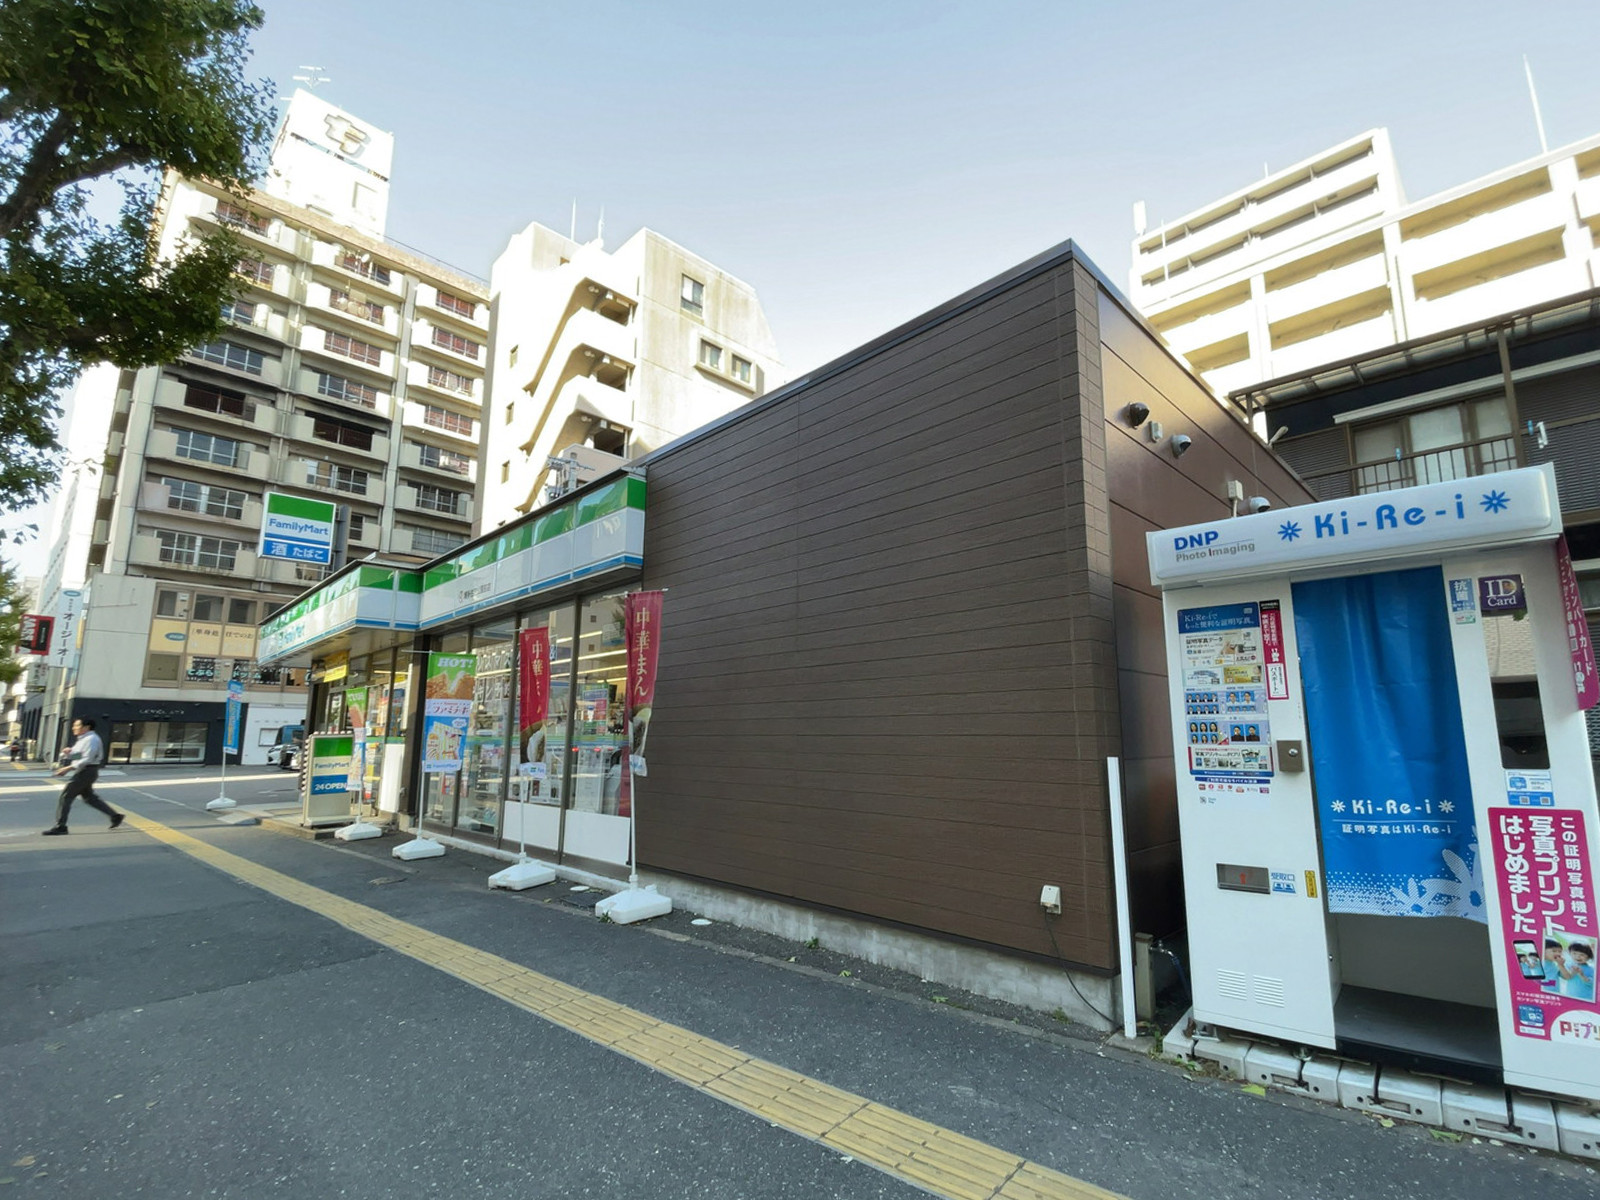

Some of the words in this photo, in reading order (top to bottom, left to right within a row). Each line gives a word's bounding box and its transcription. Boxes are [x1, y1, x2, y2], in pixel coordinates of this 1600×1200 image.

[1315, 493, 1465, 538] Ki-Re-i
[269, 518, 329, 535] FamilyMart
[271, 542, 287, 556] 酒
[293, 547, 324, 560] たばこ
[1174, 531, 1219, 551] DNP
[1176, 550, 1207, 563] Photo
[1208, 542, 1255, 557] Imaging
[1453, 580, 1469, 601] 抗菌
[1484, 579, 1518, 598] ID
[1487, 596, 1518, 607] Card
[1564, 555, 1593, 676] マイナンバーカード
[57, 612, 75, 666] オージーオー
[635, 607, 651, 696] 中華まん
[438, 658, 473, 668] HOT!
[315, 762, 349, 770] FamilyMart
[1352, 799, 1432, 814] Ki-Re-i
[1342, 823, 1451, 835] 証明写真はKi-Re-i
[1271, 872, 1295, 881] 受取口
[1500, 815, 1537, 934] はじめました
[1528, 815, 1565, 936] 写真プリント
[1561, 817, 1588, 927] この証明写真機で
